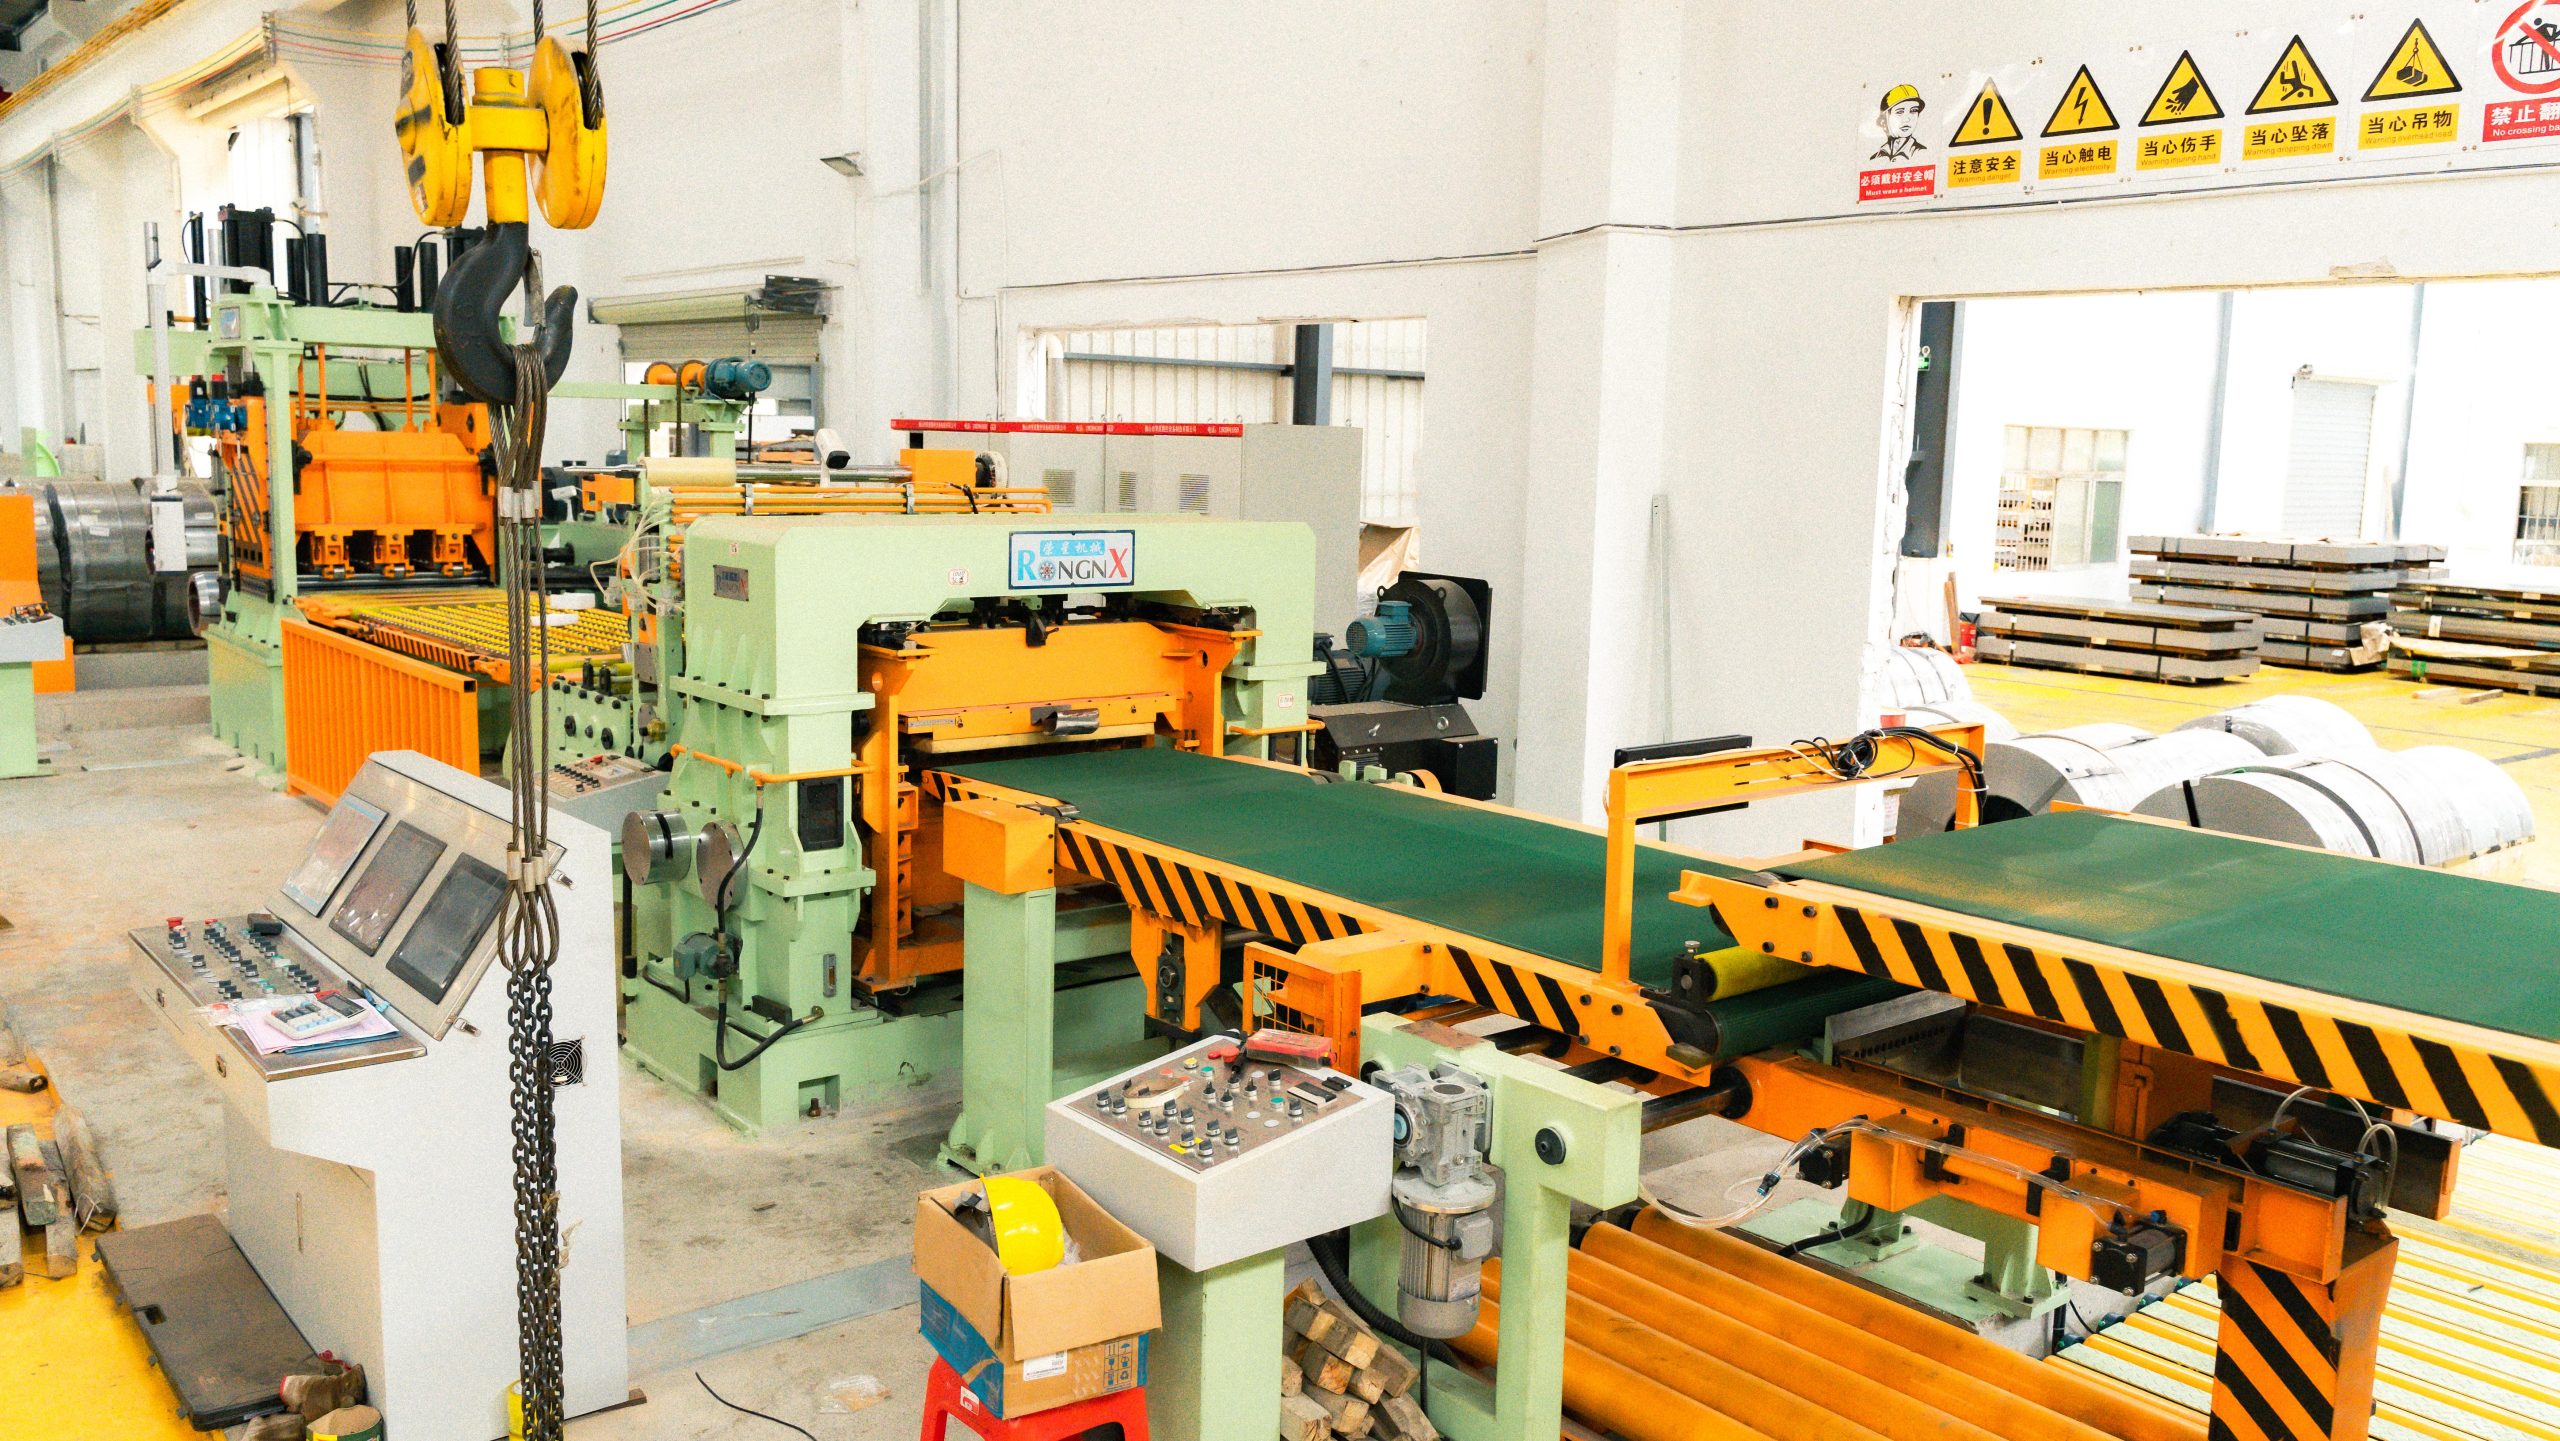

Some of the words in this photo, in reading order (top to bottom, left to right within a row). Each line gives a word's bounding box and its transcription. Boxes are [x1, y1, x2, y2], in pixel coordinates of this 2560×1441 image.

[2368, 110, 2452, 134] 当心吊物
[2252, 123, 2329, 145] 当心坠落
[2508, 126, 2546, 135] crossing
[2144, 134, 2216, 156] 当心伤手
[2366, 136, 2396, 144] Warning
[2046, 146, 2111, 166] 当心触电
[2244, 148, 2275, 156] Warning
[2277, 145, 2309, 154] dropping
[1954, 156, 2016, 175] 注意安全
[2075, 164, 2110, 172] electricity
[2141, 158, 2169, 166] Warning
[1861, 170, 1934, 186] 必须戴好安全帽
